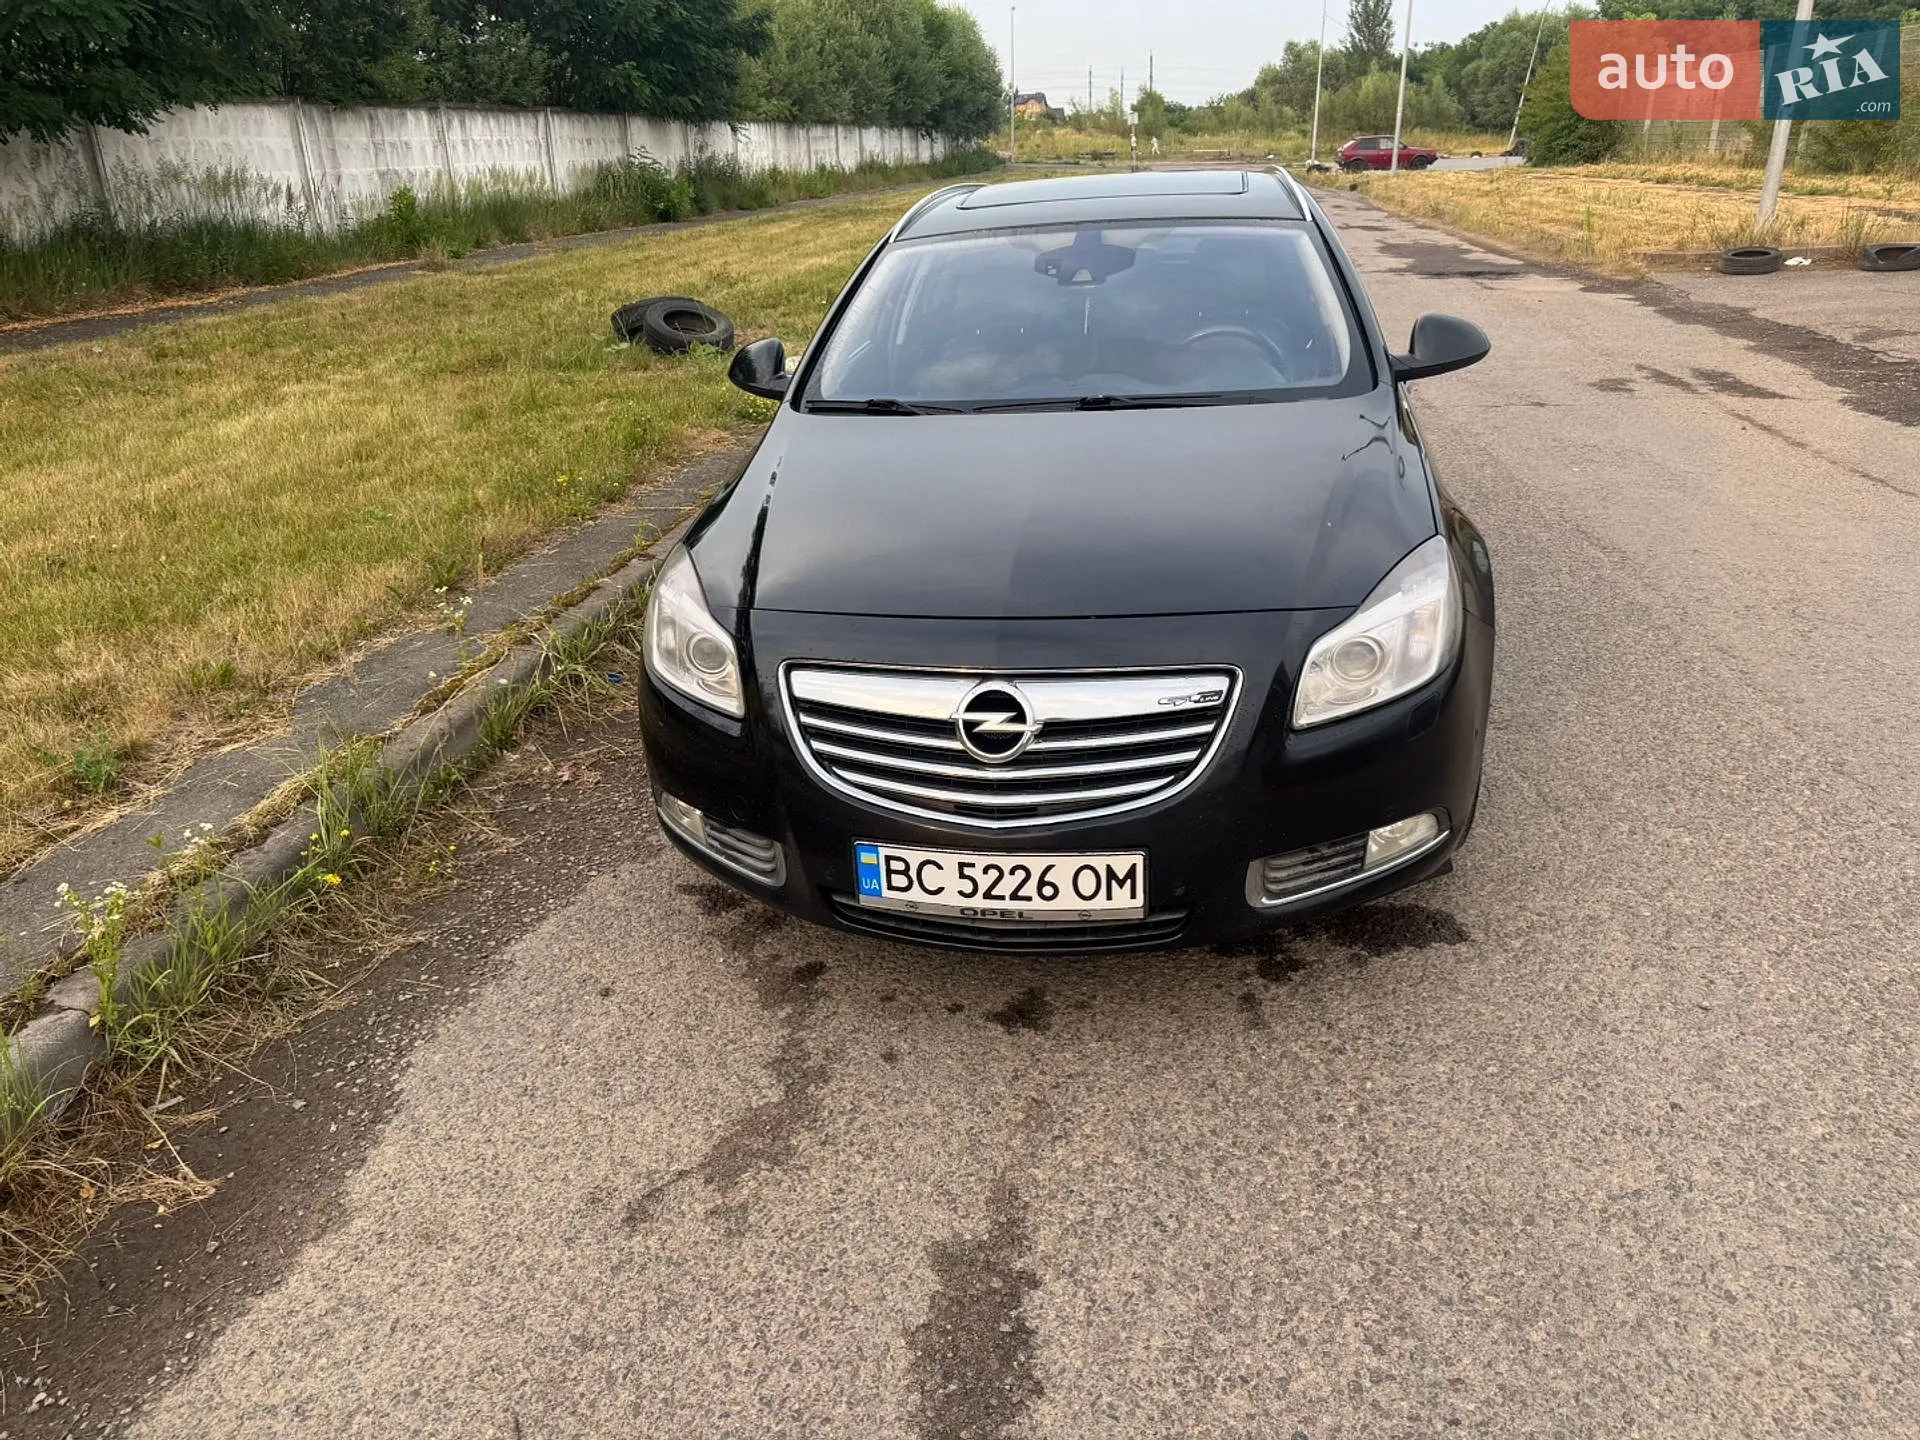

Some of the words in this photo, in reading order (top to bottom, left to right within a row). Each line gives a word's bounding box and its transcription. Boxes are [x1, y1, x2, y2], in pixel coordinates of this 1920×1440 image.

[862, 878, 879, 890] UA
[884, 855, 945, 896] BC
[957, 862, 1060, 901] 5226
[1072, 863, 1137, 901] OM
[960, 907, 1034, 919] OPEL
